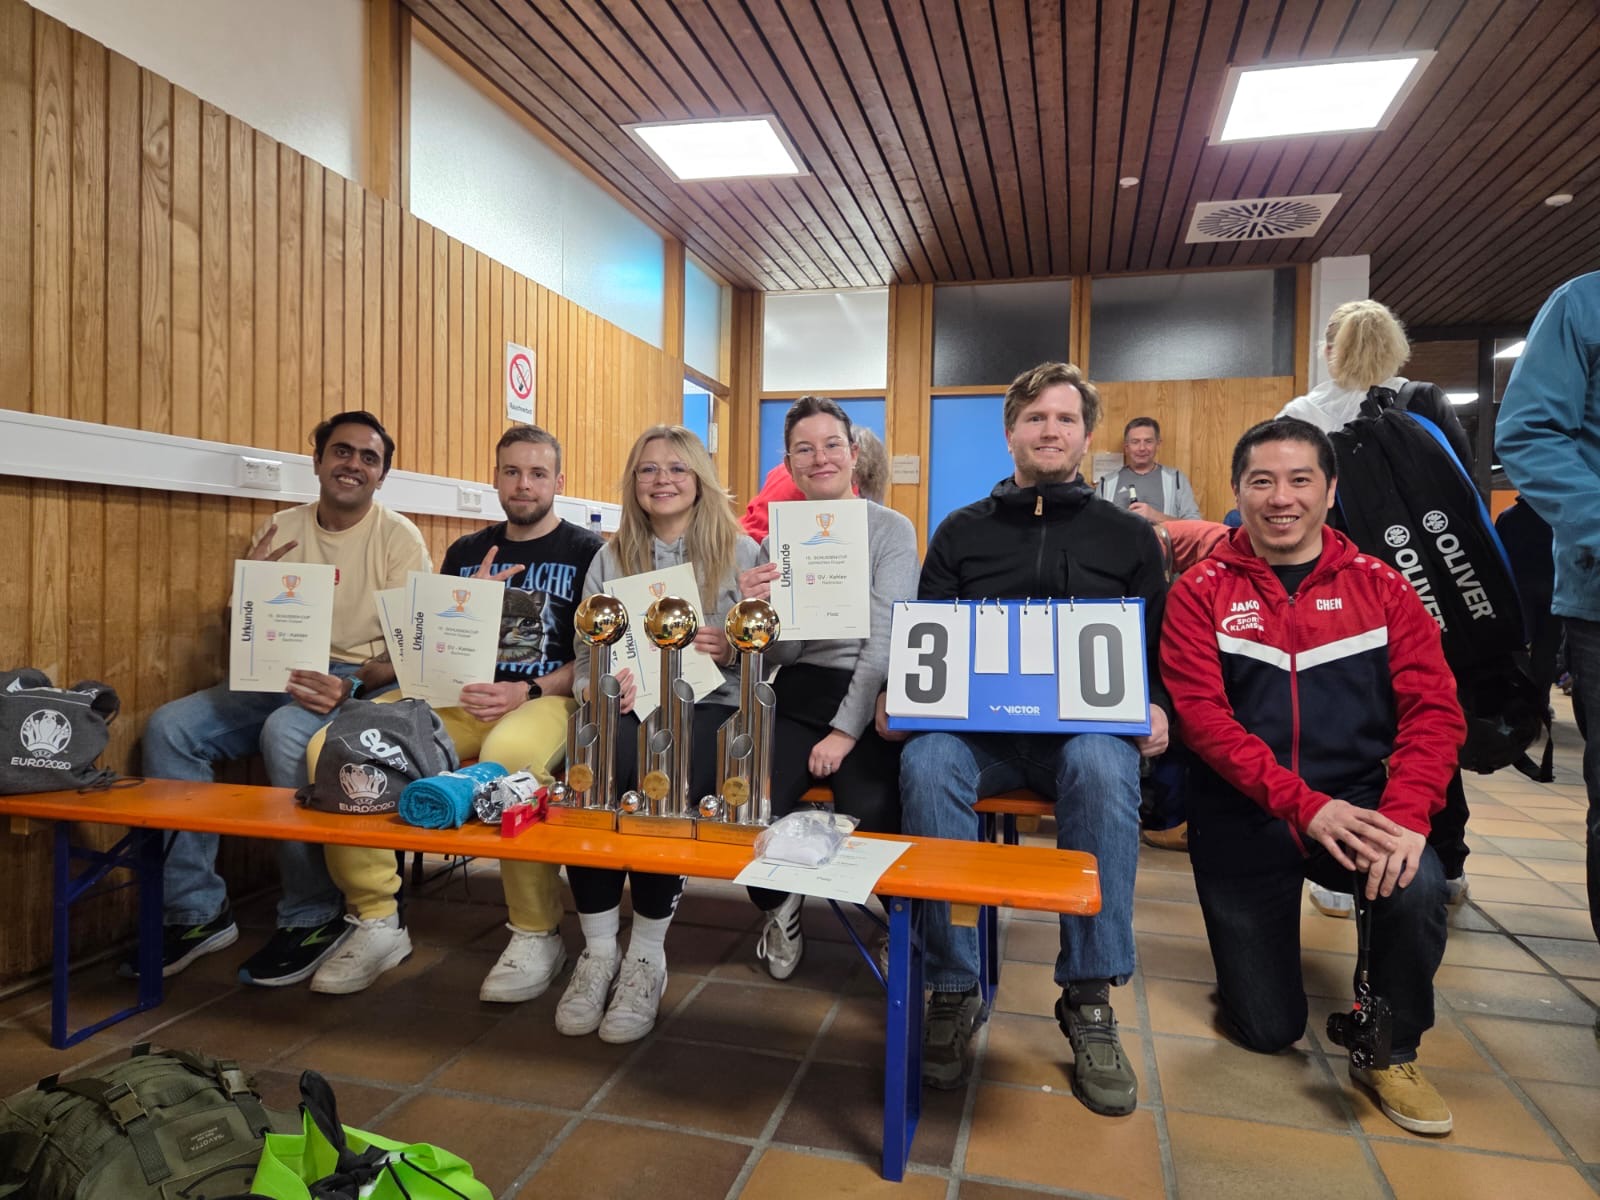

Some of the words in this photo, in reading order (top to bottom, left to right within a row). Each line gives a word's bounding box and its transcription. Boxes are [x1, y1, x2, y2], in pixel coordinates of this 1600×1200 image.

[521, 562, 577, 602] ACHE
[780, 543, 791, 588] Urkunde
[1436, 533, 1494, 620] OLIVER
[241, 600, 254, 642] Urkunde
[1231, 600, 1260, 612] JAKO
[1316, 598, 1343, 611] CHEN
[412, 611, 425, 651] Urkunde
[905, 622, 949, 704] 3
[1078, 623, 1125, 707] 0
[1003, 705, 1040, 714] VICTOR
[11, 756, 71, 770] EURO2020
[339, 800, 396, 813] EURO2020
